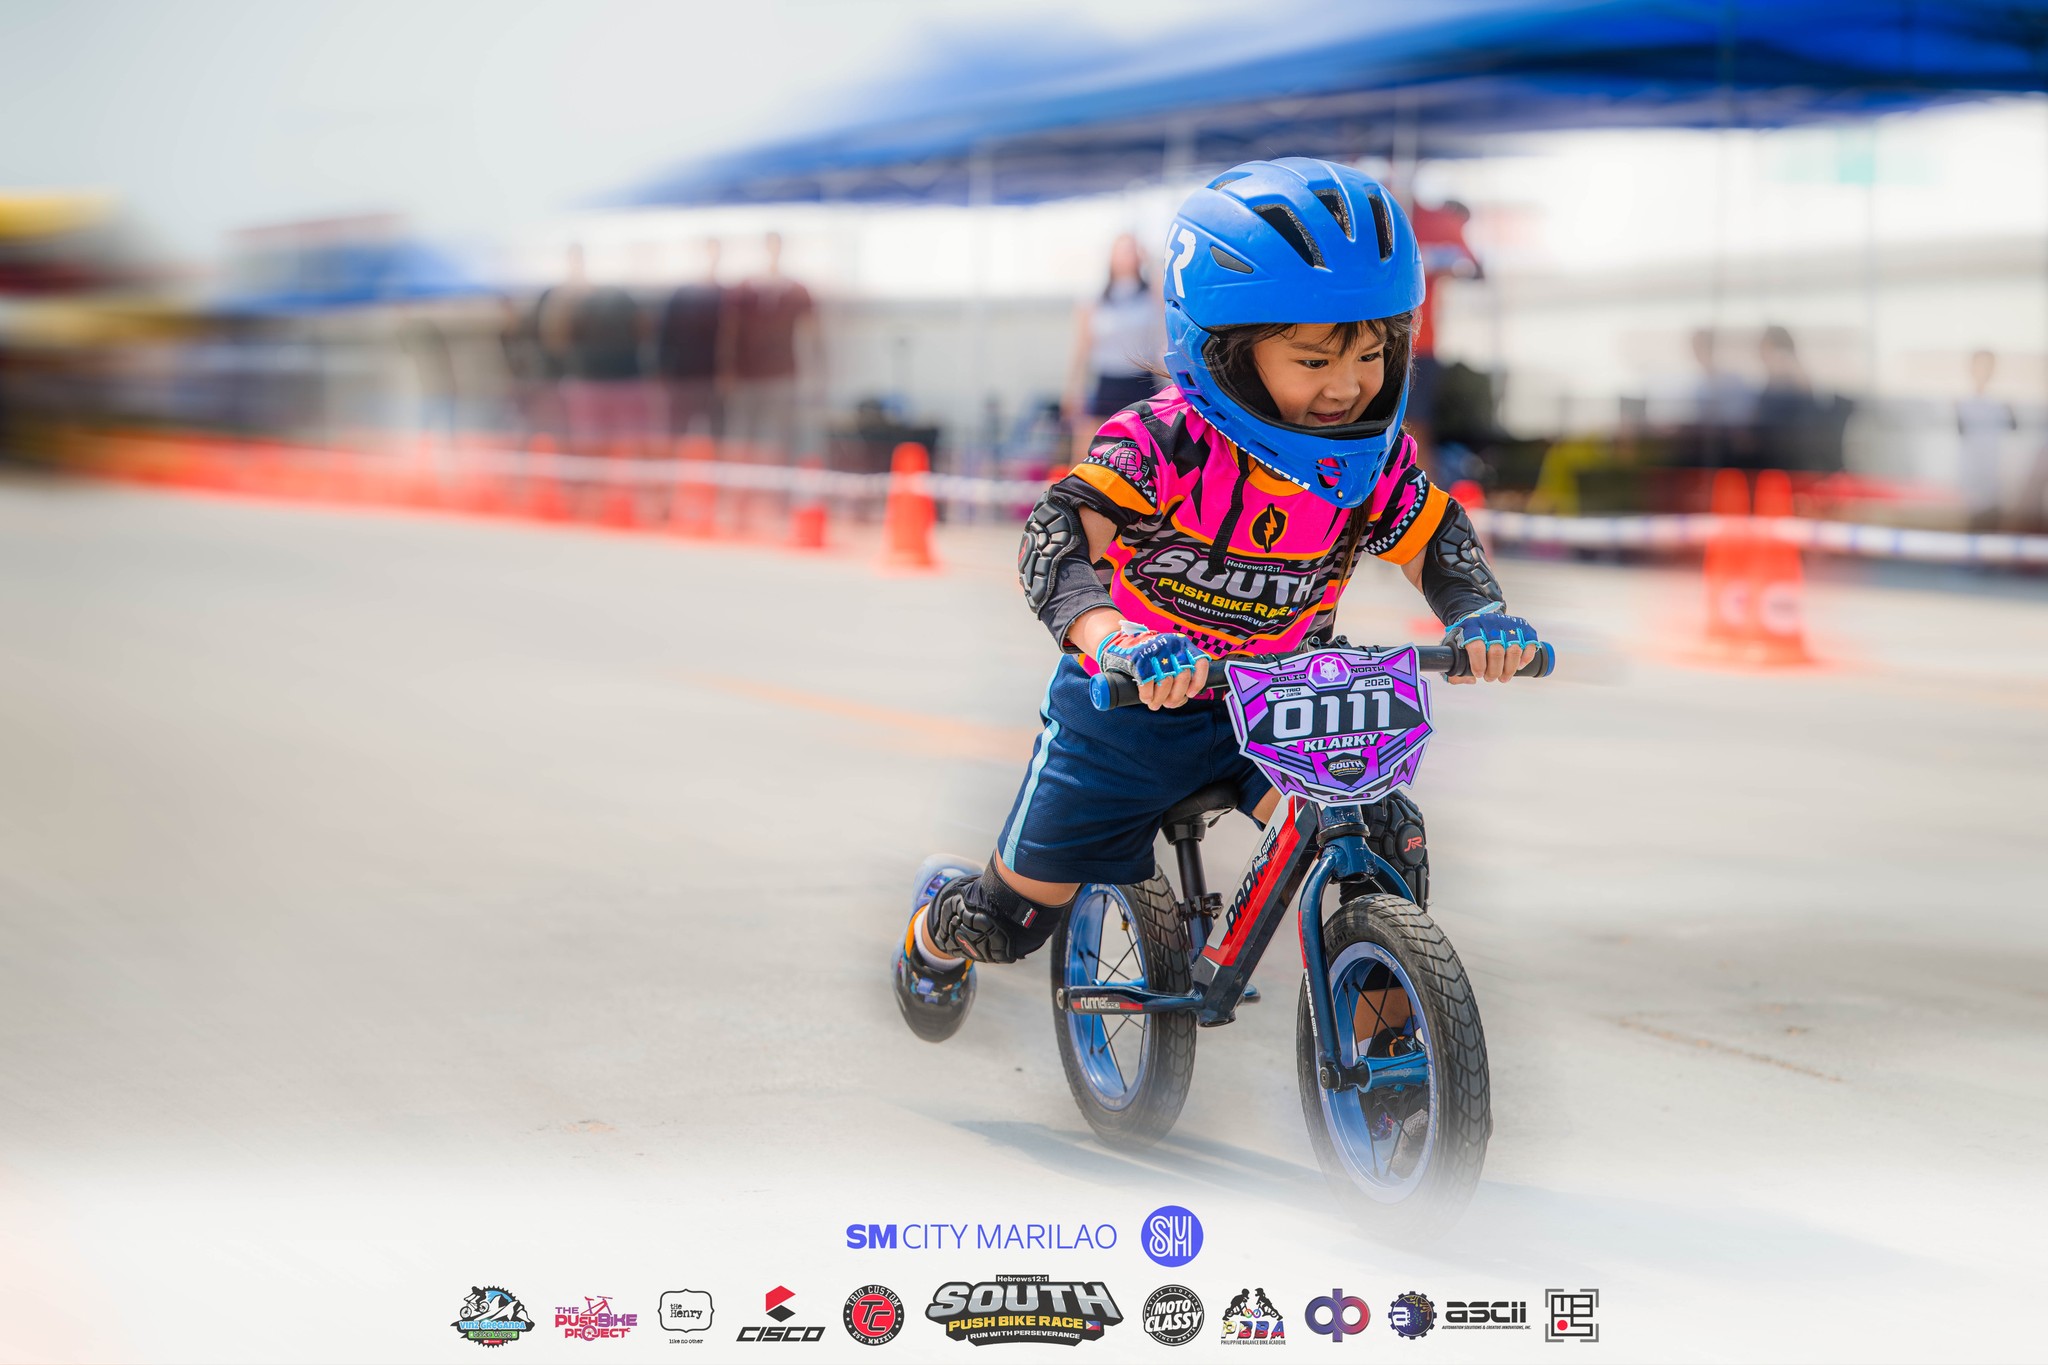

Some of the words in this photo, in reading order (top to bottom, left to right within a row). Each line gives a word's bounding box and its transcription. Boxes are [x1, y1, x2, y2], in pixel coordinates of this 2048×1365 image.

[1226, 560, 1281, 573] Hebrews12:1
[1143, 549, 1317, 606] SOUTH
[1158, 577, 1211, 602] PUSH
[1211, 595, 1254, 613] BIKE
[1177, 597, 1198, 610] RUN
[1198, 604, 1225, 618] WITH
[1271, 673, 1307, 683] SOLID
[1351, 665, 1385, 674] NORTH
[1364, 678, 1390, 687] 2026
[1272, 690, 1391, 740] 0111
[1303, 733, 1379, 753] KLARKY
[1329, 760, 1365, 771] SOUTH
[1080, 997, 1108, 1009] runner
